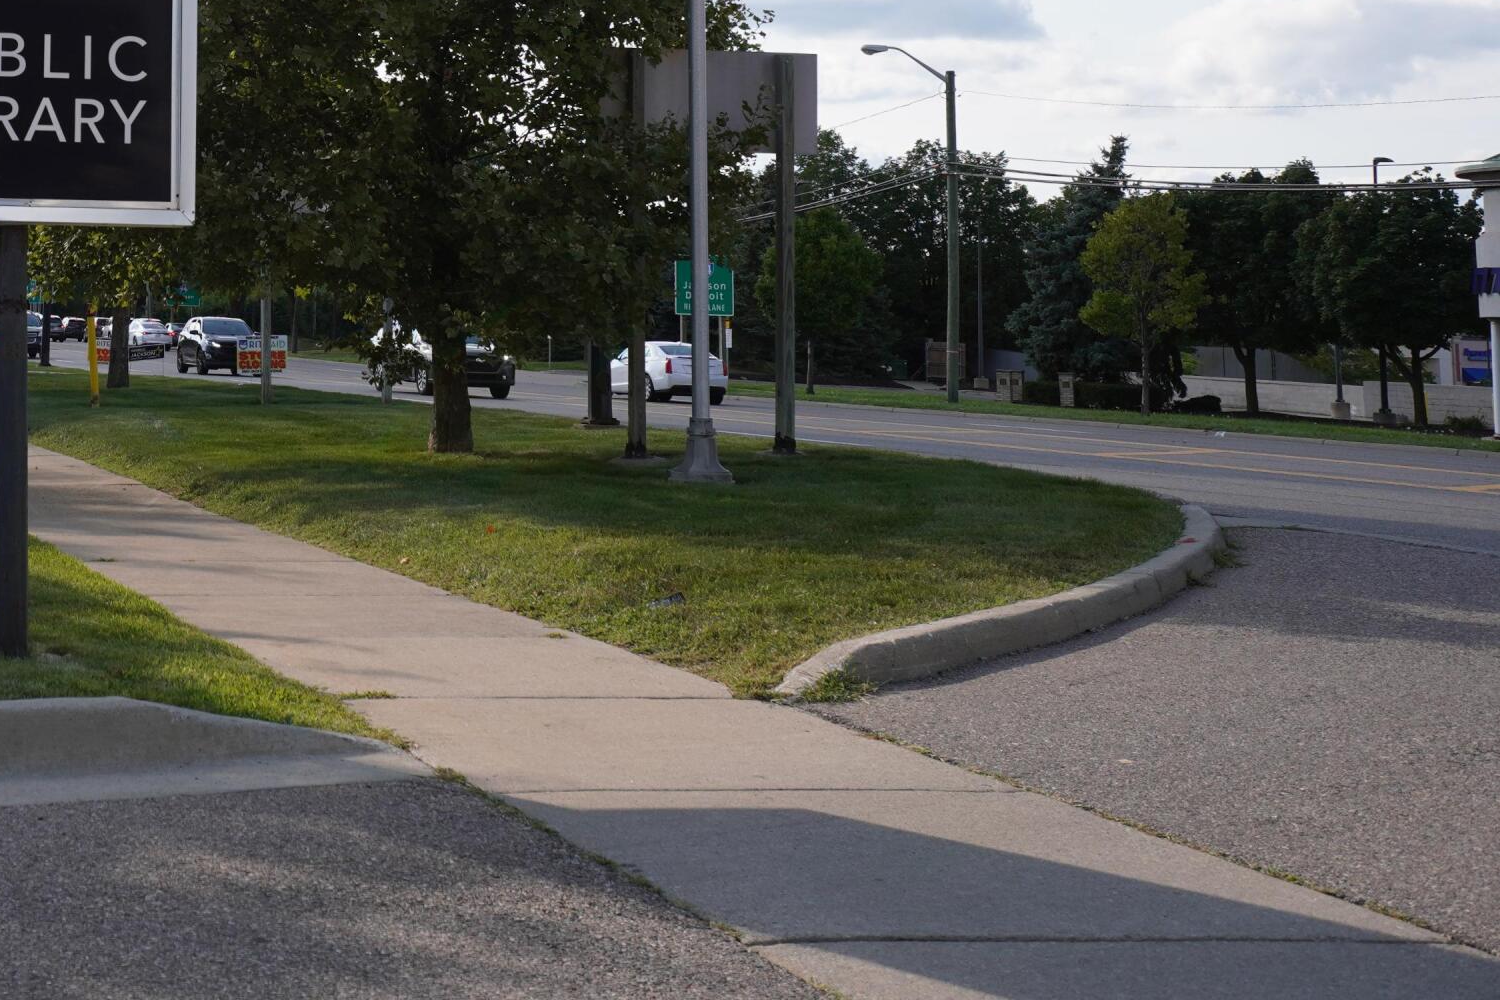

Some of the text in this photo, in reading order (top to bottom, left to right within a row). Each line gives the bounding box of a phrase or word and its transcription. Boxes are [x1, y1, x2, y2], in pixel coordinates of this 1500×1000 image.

[683, 281, 726, 290] Jason
[685, 291, 724, 301] Doit
[249, 340, 261, 349] RIT
[239, 360, 285, 369] CLONG
